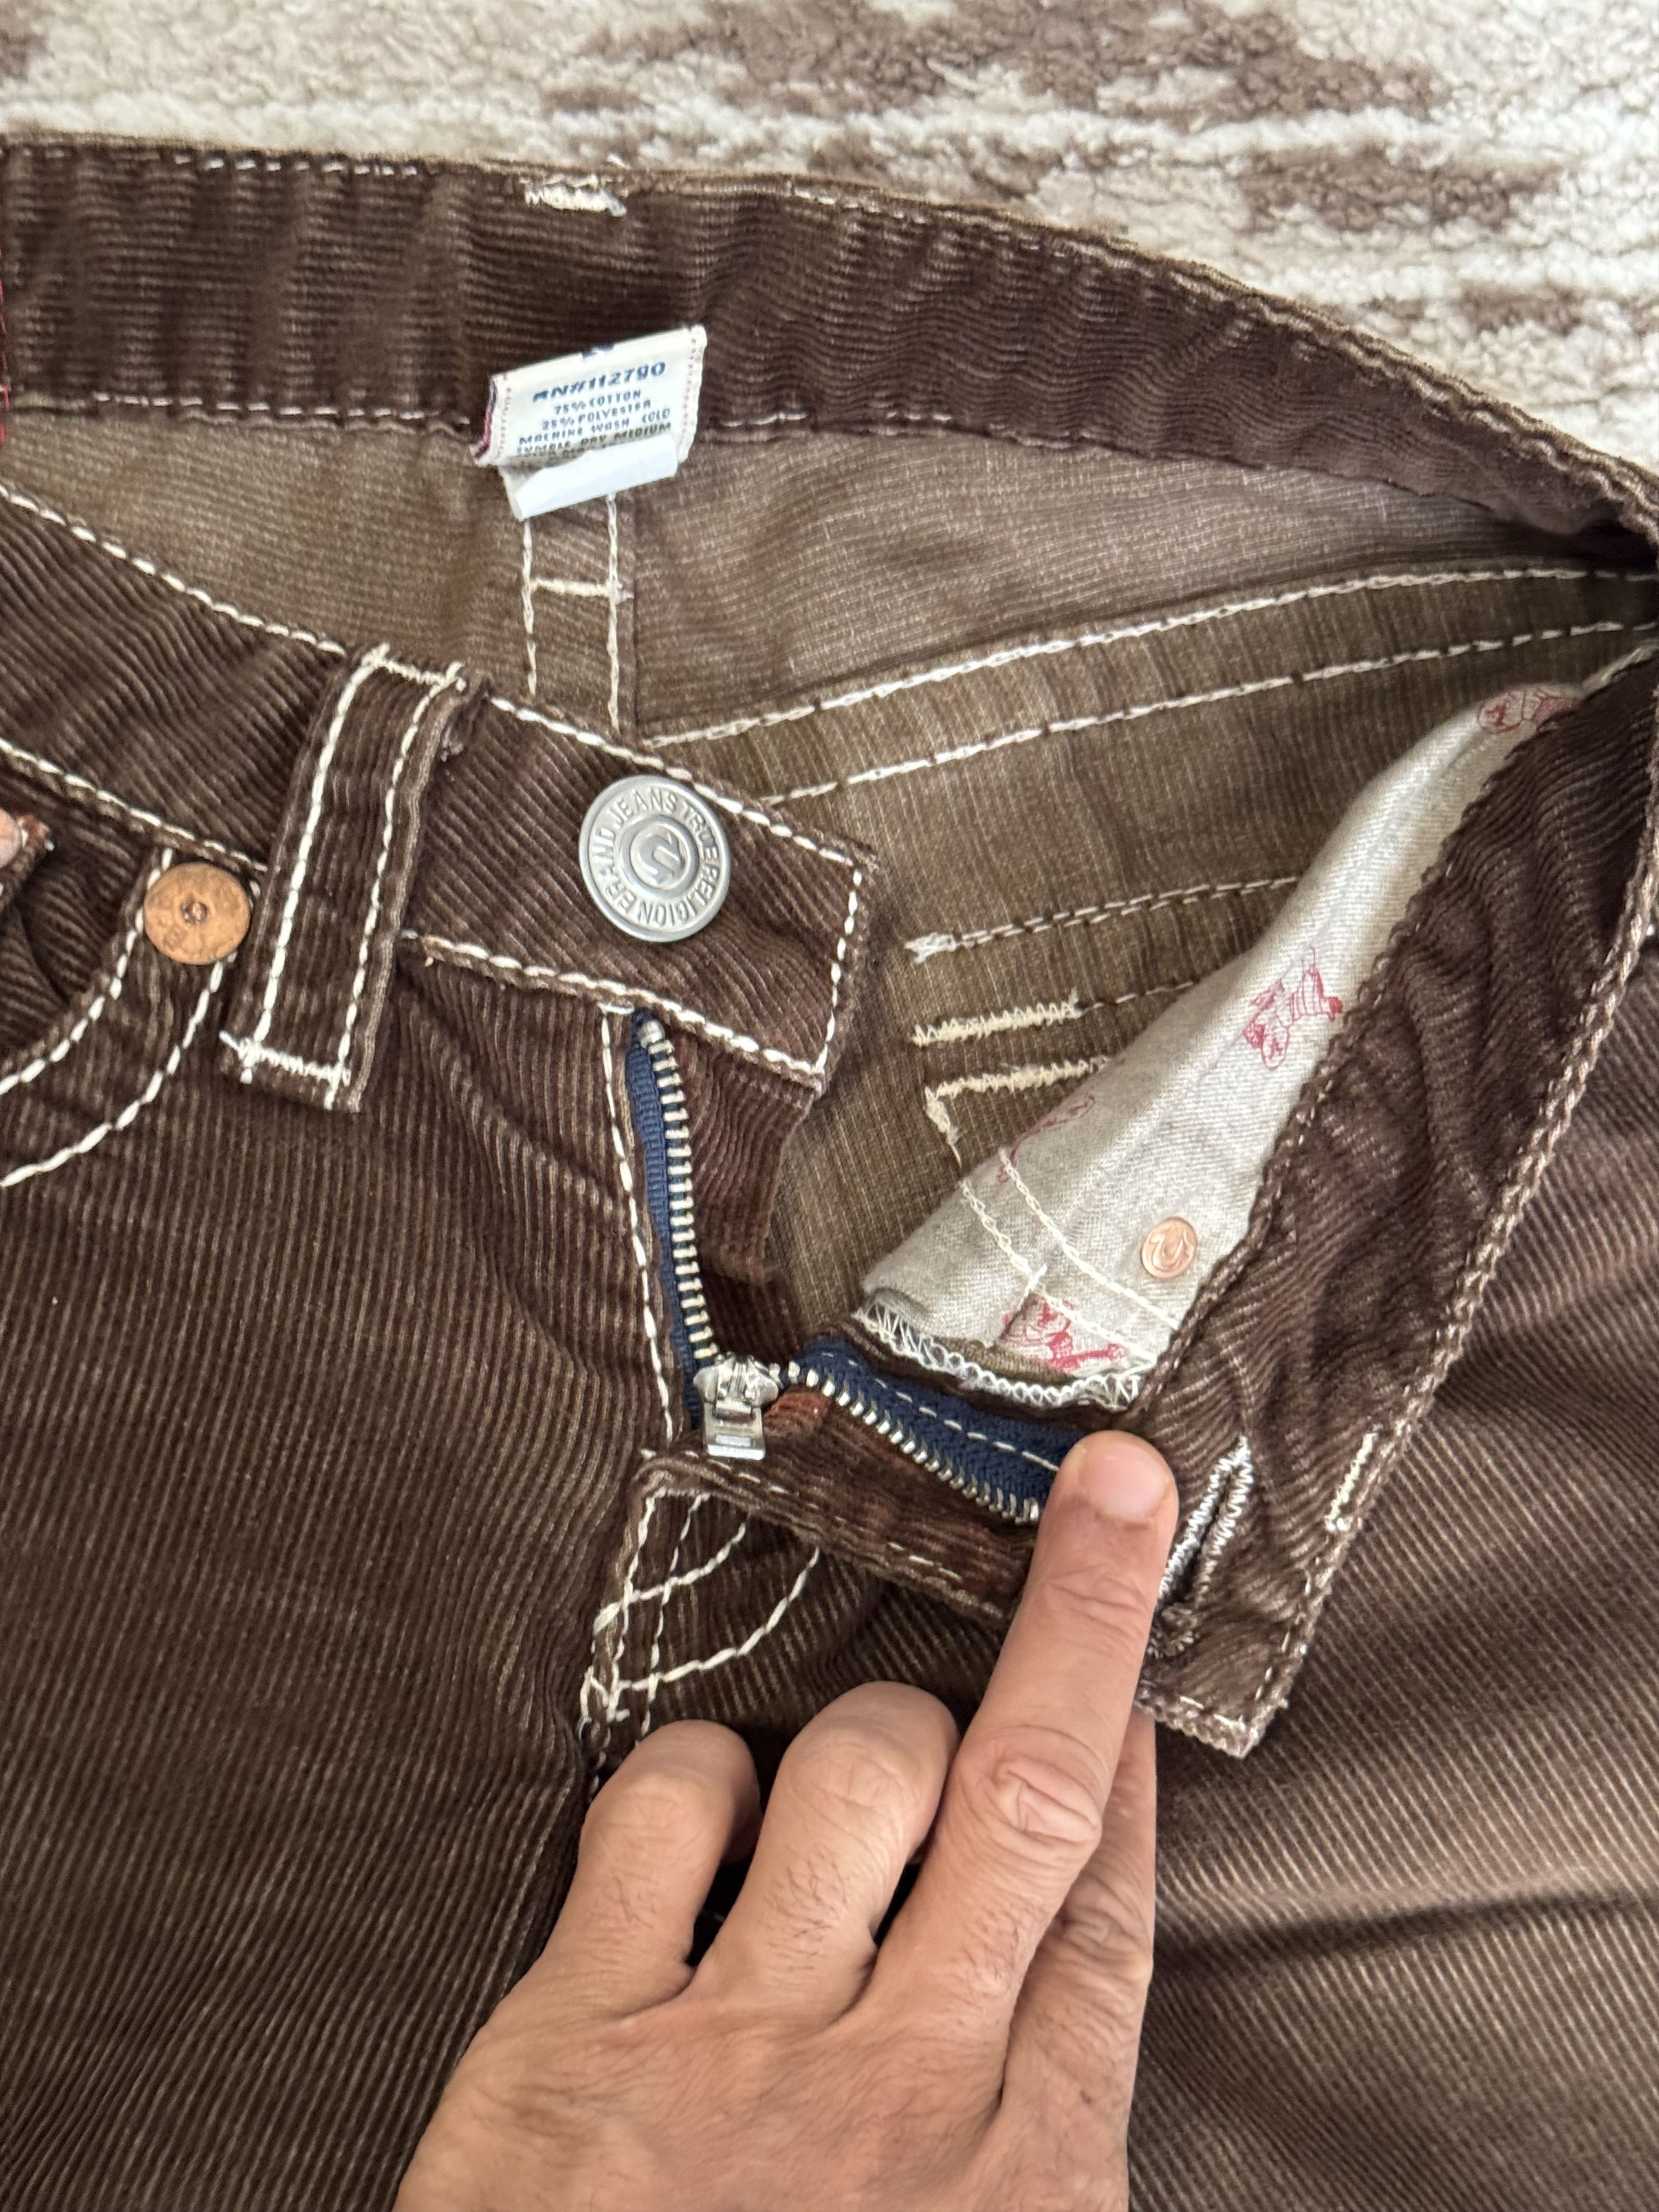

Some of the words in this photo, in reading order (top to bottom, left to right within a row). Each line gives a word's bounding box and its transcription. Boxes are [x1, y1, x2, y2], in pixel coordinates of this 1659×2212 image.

[542, 417, 574, 430] 25%
[578, 399, 651, 423] POLYESTER
[555, 401, 586, 415] 75%
[589, 390, 641, 407] COTTON
[519, 427, 583, 445] MACHINE
[591, 418, 629, 433] WASH
[642, 408, 670, 424] COLD
[581, 435, 607, 446] DRY
[613, 422, 671, 441] MEDIUM
[607, 787, 678, 829] JEANS
[681, 800, 720, 860] TRUE
